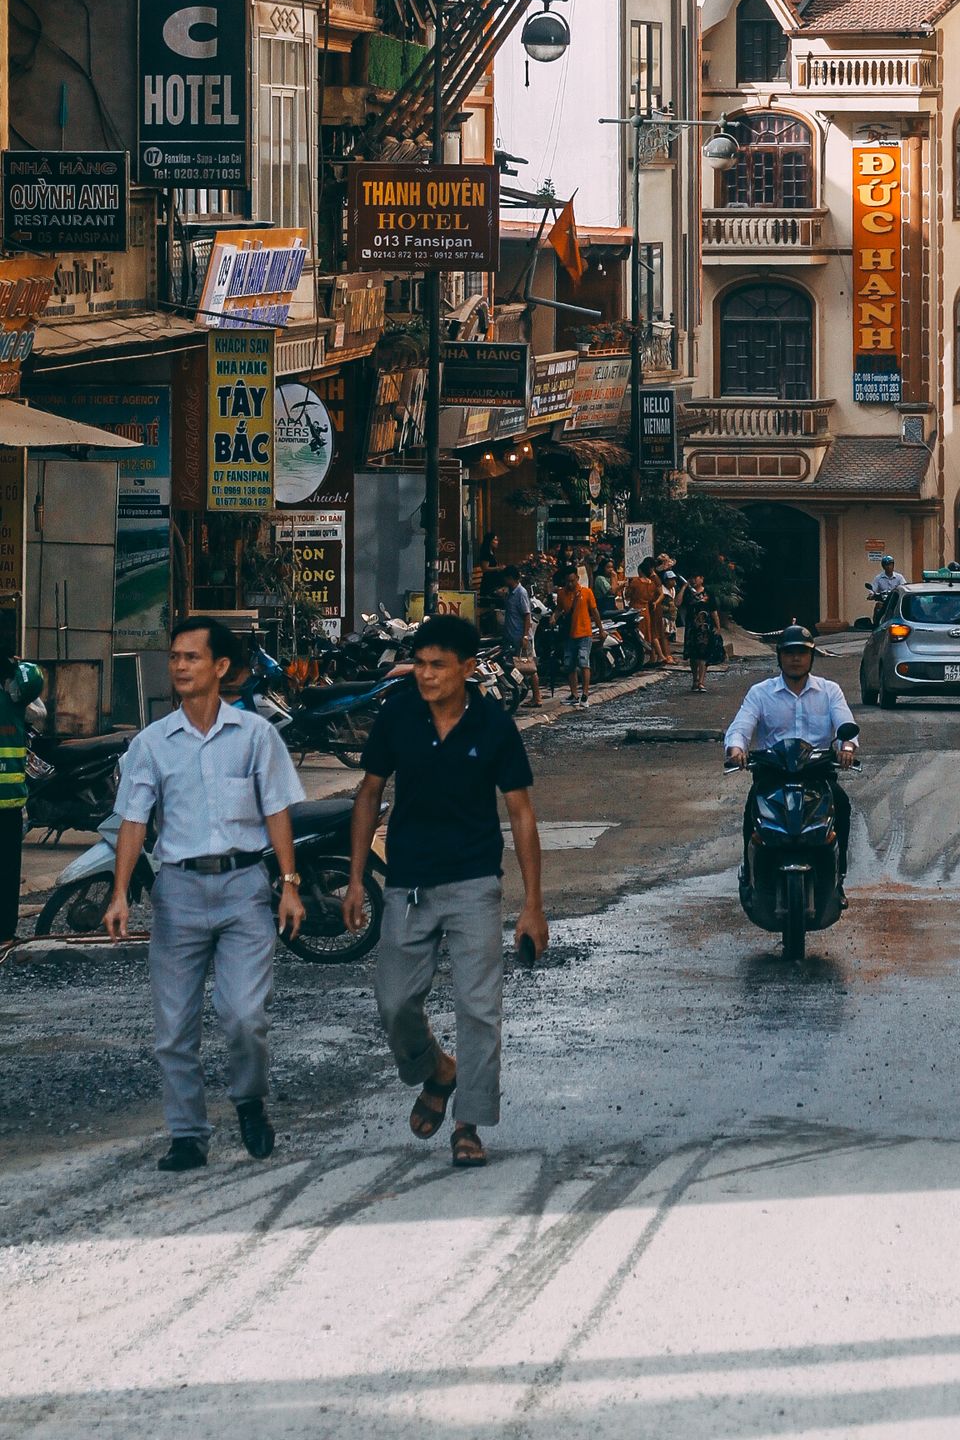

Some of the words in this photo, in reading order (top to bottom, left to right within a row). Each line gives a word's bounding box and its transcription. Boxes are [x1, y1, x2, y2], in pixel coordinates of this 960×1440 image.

[144, 74, 240, 125] HOTEL
[146, 151, 160, 163] 07
[153, 168, 171, 179] Tel:
[10, 178, 75, 210] QUỲNH
[78, 184, 119, 210] ANH
[363, 181, 421, 206] THANH
[427, 177, 485, 209] QUYÊN
[14, 214, 116, 226] RESTAURANT
[377, 213, 470, 230] HOTEL
[374, 235, 400, 248] 013
[404, 235, 473, 250] Fansipan
[373, 251, 396, 259] 02143
[414, 251, 428, 259] 123
[434, 251, 452, 259] 0912
[858, 248, 896, 350] HẠNH
[122, 396, 160, 405] AGENCY
[217, 379, 267, 417] TÂY
[643, 397, 670, 413] HELLO
[275, 418, 302, 427] APA
[643, 418, 671, 435] VIETNAM
[214, 420, 270, 464] BẮC
[213, 470, 224, 481] 07
[227, 470, 269, 482] FANSIPAN
